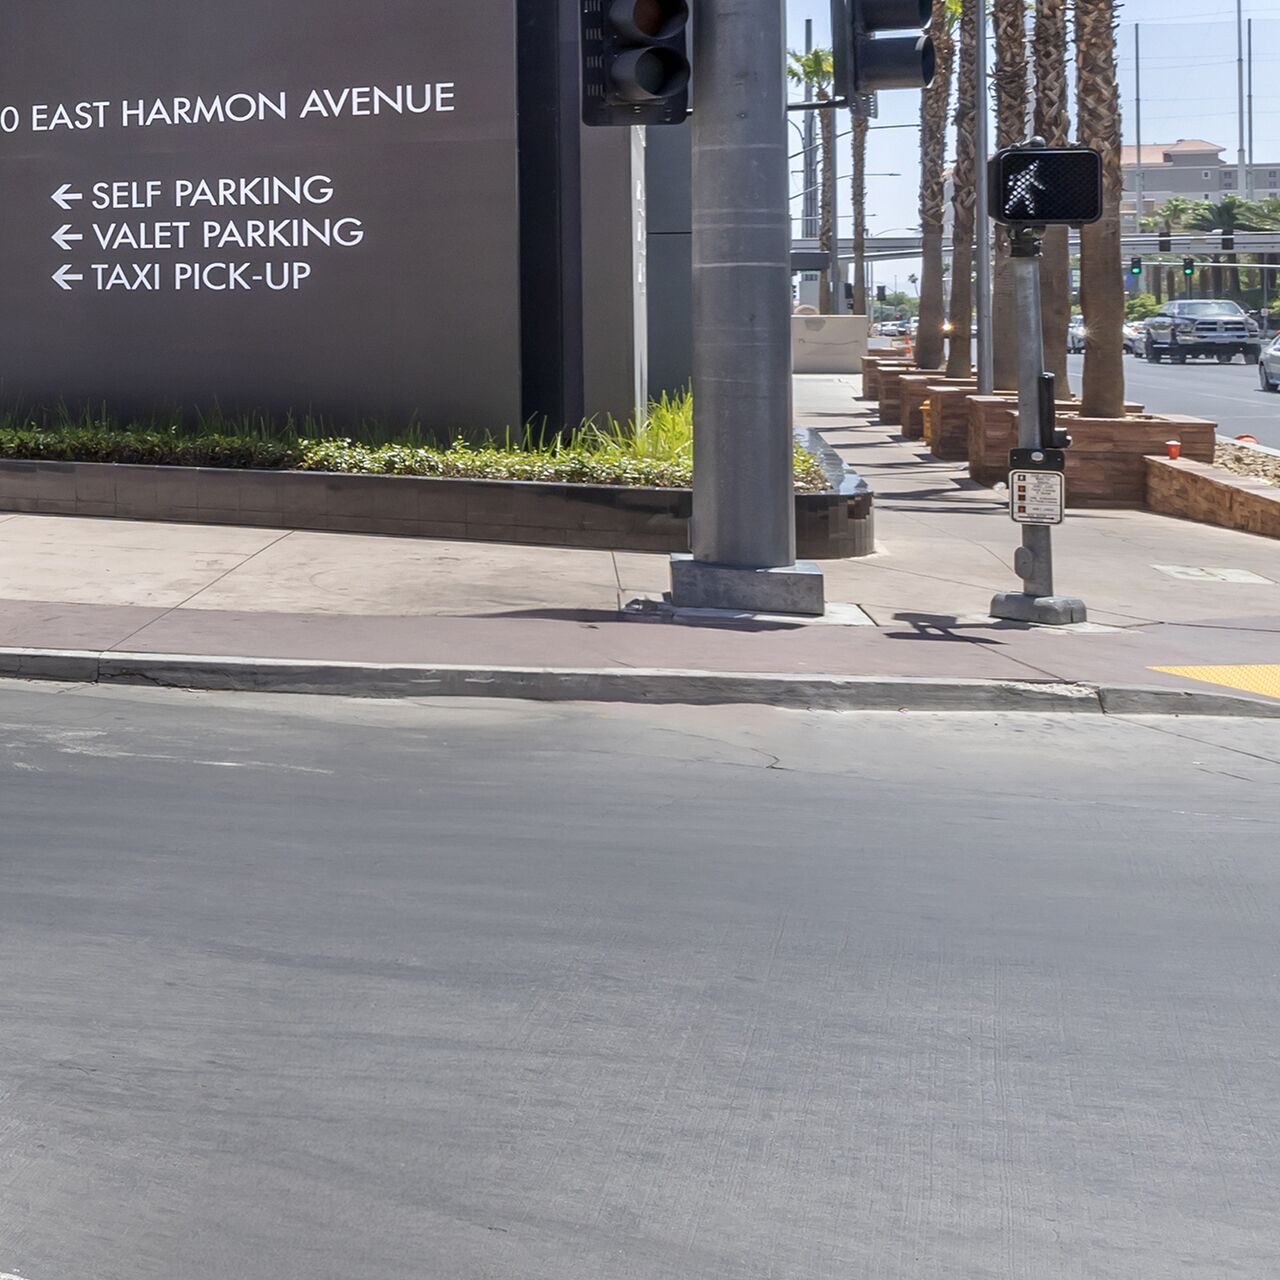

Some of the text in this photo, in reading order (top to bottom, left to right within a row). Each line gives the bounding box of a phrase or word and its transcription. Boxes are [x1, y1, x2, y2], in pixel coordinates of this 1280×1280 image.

[33, 102, 109, 130] EAST
[123, 92, 285, 126] HARMON
[300, 83, 454, 118] AVENUE
[92, 176, 333, 209] SELF PARKING
[93, 218, 363, 249] VALET PARKING
[91, 263, 310, 289] TAXI PICK-UP
